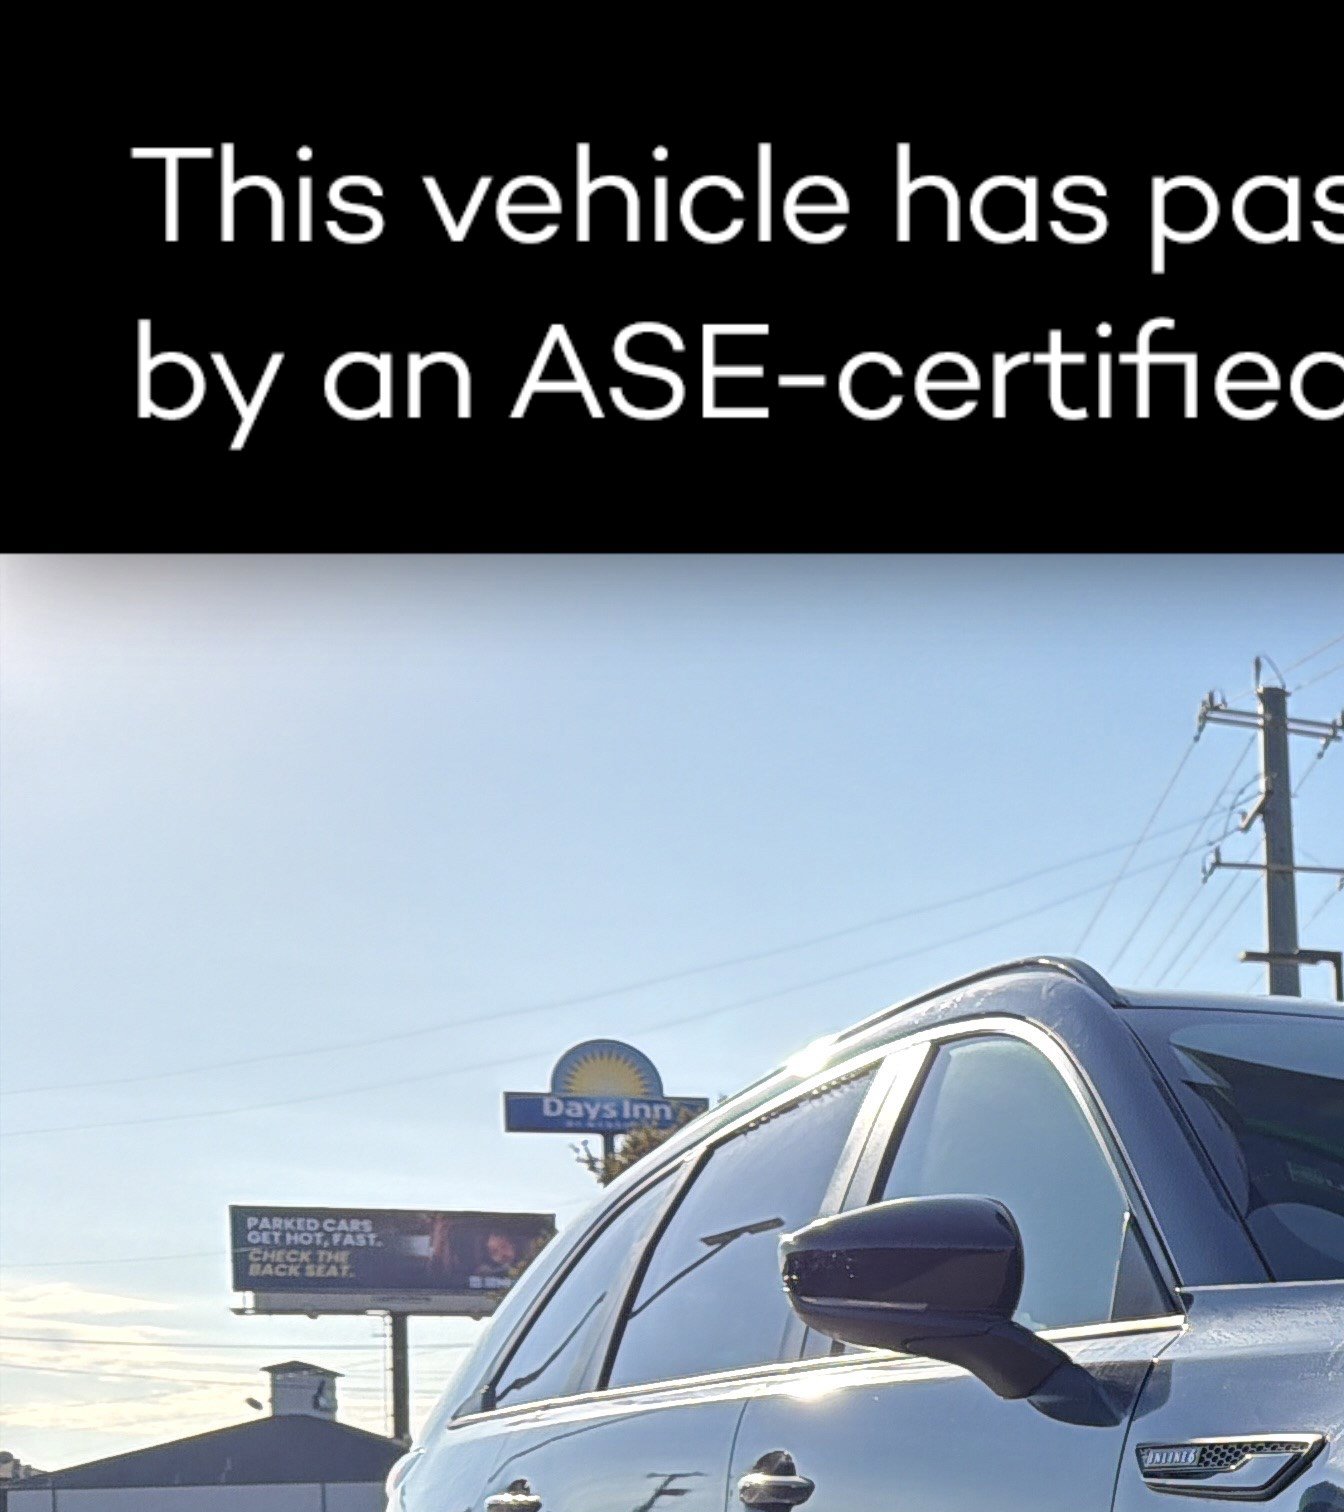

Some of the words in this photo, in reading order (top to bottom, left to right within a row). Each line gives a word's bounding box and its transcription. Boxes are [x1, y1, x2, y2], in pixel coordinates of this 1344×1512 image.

[542, 1096, 617, 1121] Days
[622, 1099, 673, 1121] Inn
[246, 1216, 320, 1232] PARKED
[322, 1218, 373, 1233] CARS
[247, 1231, 281, 1245] GET
[285, 1232, 330, 1248] HOT,
[248, 1248, 312, 1263] CHECK
[317, 1249, 350, 1263] THE
[248, 1263, 301, 1277] BACK
